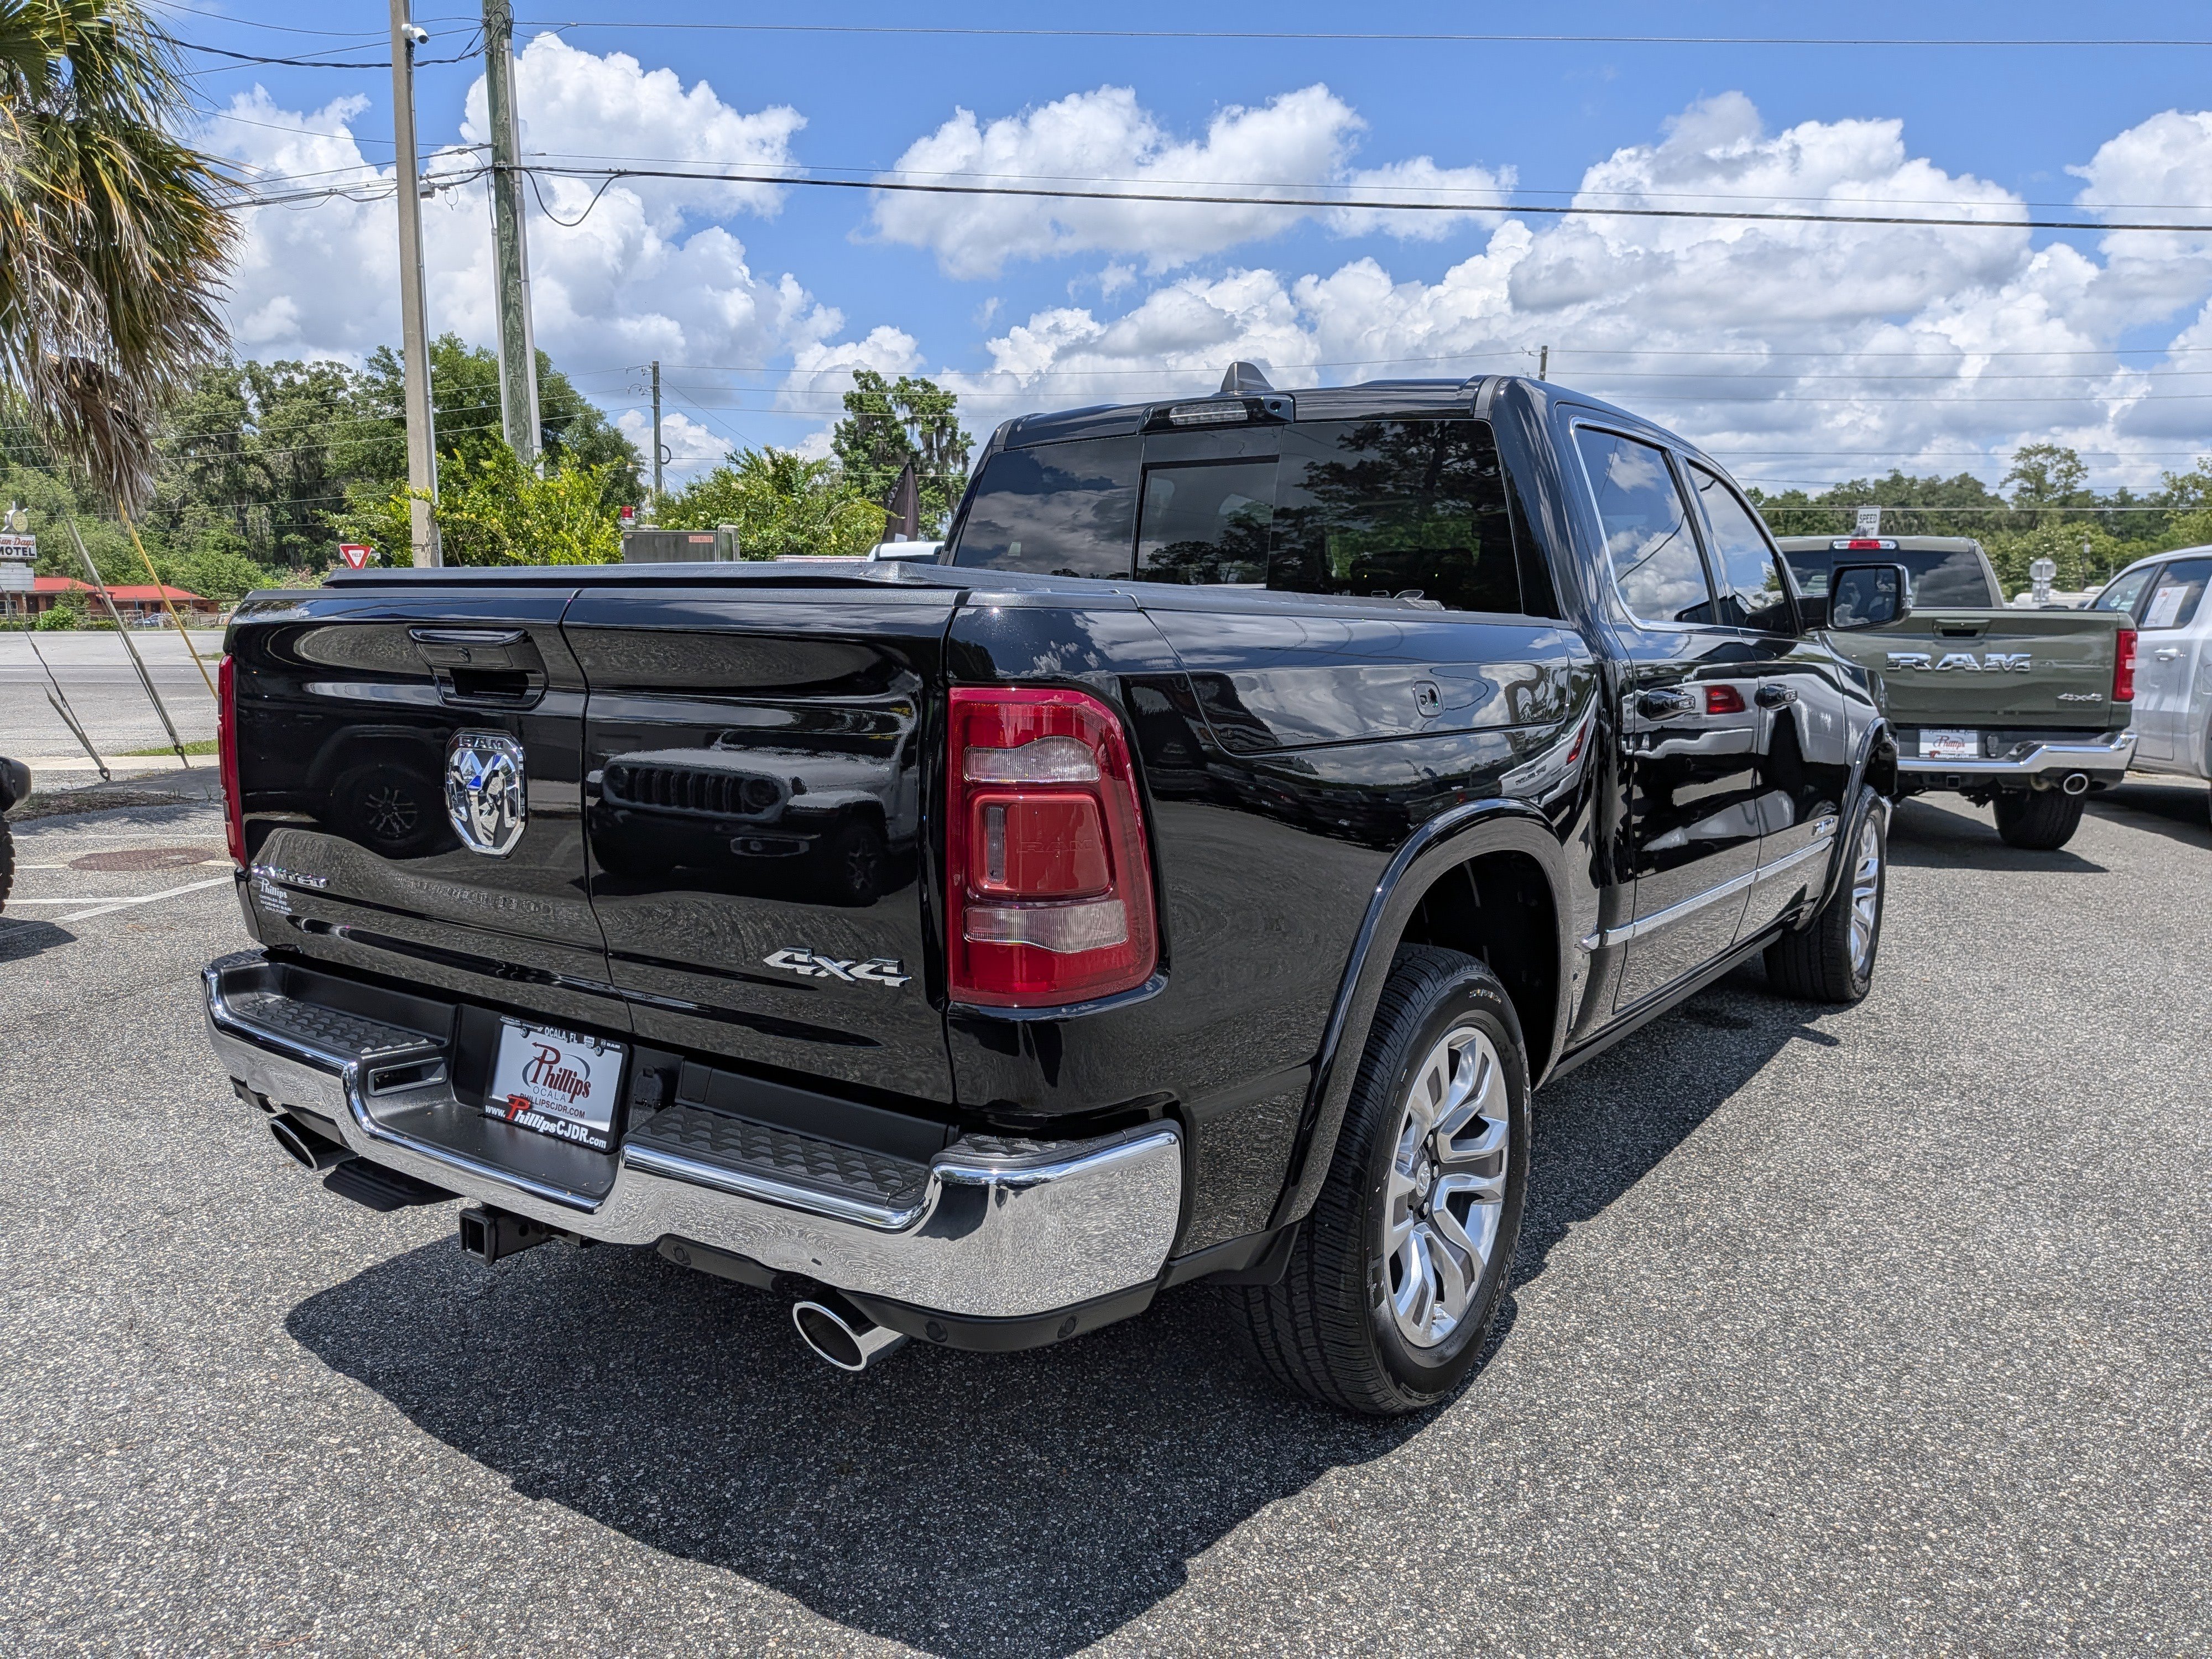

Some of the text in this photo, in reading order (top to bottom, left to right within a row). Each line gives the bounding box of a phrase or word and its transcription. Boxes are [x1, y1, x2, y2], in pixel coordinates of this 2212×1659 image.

[1859, 514, 1877, 523] SPEED
[0, 537, 34, 547] un-Days
[1886, 652, 2032, 671] RAM
[459, 736, 504, 750] RAM
[1018, 839, 1092, 853] RAM
[257, 877, 288, 899] Phillips
[545, 1027, 578, 1043] OCALA, FL
[530, 1042, 591, 1104] Phillips
[533, 1086, 566, 1102] OCALA
[485, 1093, 607, 1149] www.PhillipsCJDR.com
